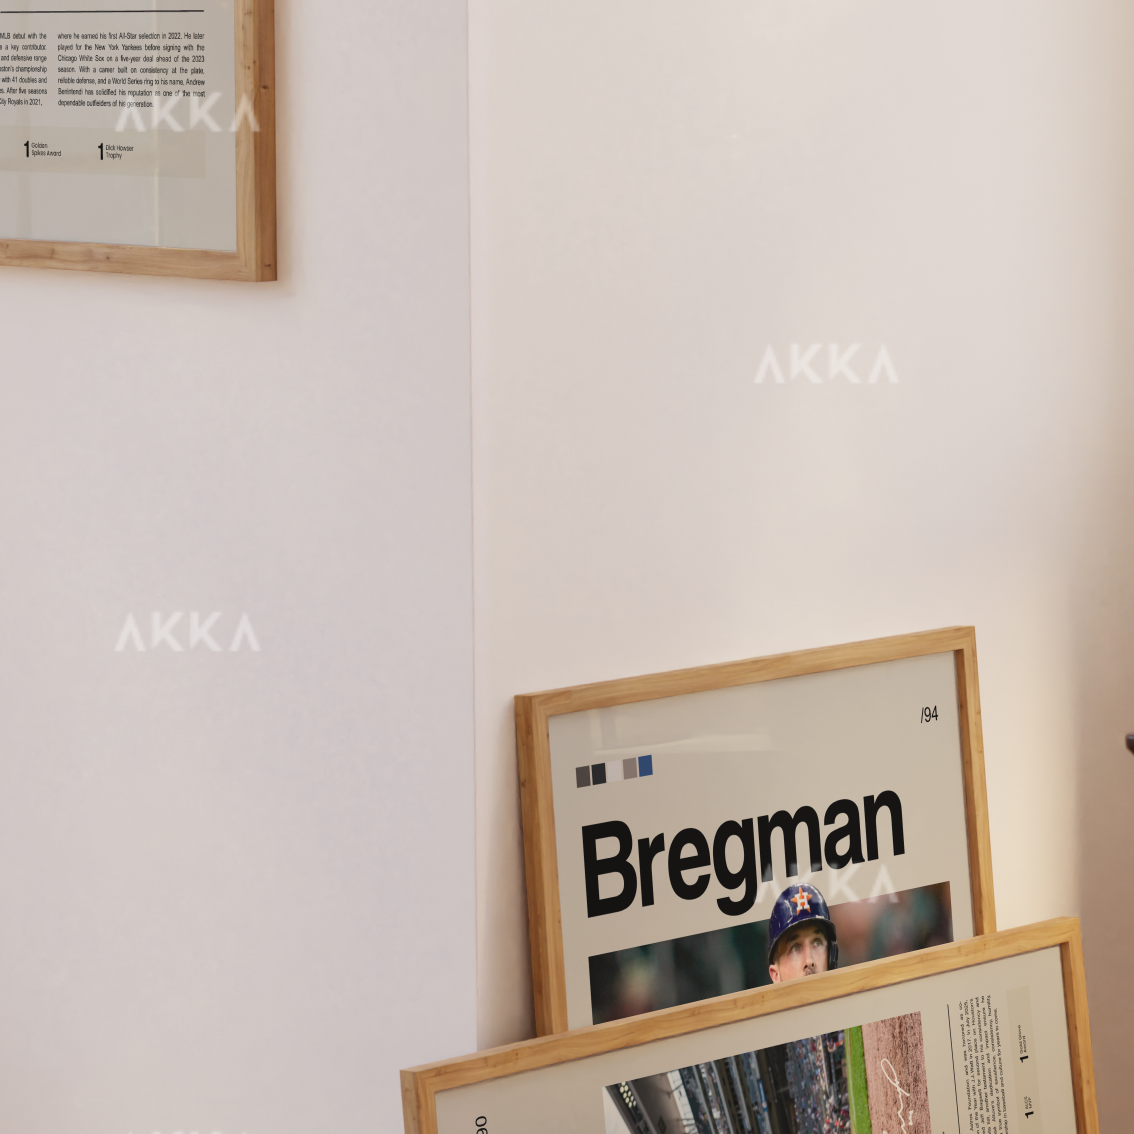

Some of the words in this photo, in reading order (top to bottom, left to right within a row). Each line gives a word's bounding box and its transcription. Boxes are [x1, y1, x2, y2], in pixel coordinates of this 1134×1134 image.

[0, 31, 11, 39] MLB
[107, 31, 118, 39] first
[138, 31, 160, 39] selection
[161, 31, 166, 39] in
[167, 31, 182, 39] 2022.
[183, 31, 191, 39] He
[10, 43, 19, 52] key
[57, 43, 73, 52] played
[74, 42, 82, 50] for
[121, 43, 142, 51] Yankees
[144, 43, 161, 51] before
[162, 43, 181, 52] signing
[183, 43, 194, 51] with
[196, 43, 205, 51] the
[57, 53, 77, 63] Chicago
[142, 54, 154, 62] deal
[155, 54, 172, 62] ahead
[173, 54, 179, 62] of
[78, 65, 90, 73] With
[117, 65, 128, 73] built
[139, 66, 168, 75] consistency
[190, 66, 205, 76] plate,
[57, 76, 75, 84] reliable
[75, 76, 97, 85] defense,
[96, 76, 107, 84] and
[111, 76, 126, 84] World
[126, 77, 143, 85] Series
[143, 77, 154, 86] ring
[159, 77, 168, 85] his
[185, 77, 205, 85] Andrew
[24, 140, 29, 158] 1
[31, 149, 46, 157] Spikes
[98, 142, 104, 160] 1
[105, 152, 123, 160] Trophy
[921, 706, 939, 724] /94
[581, 790, 906, 919] Bregman
[1019, 1055, 1029, 1063] 1
[1024, 1111, 1034, 1119] 1
